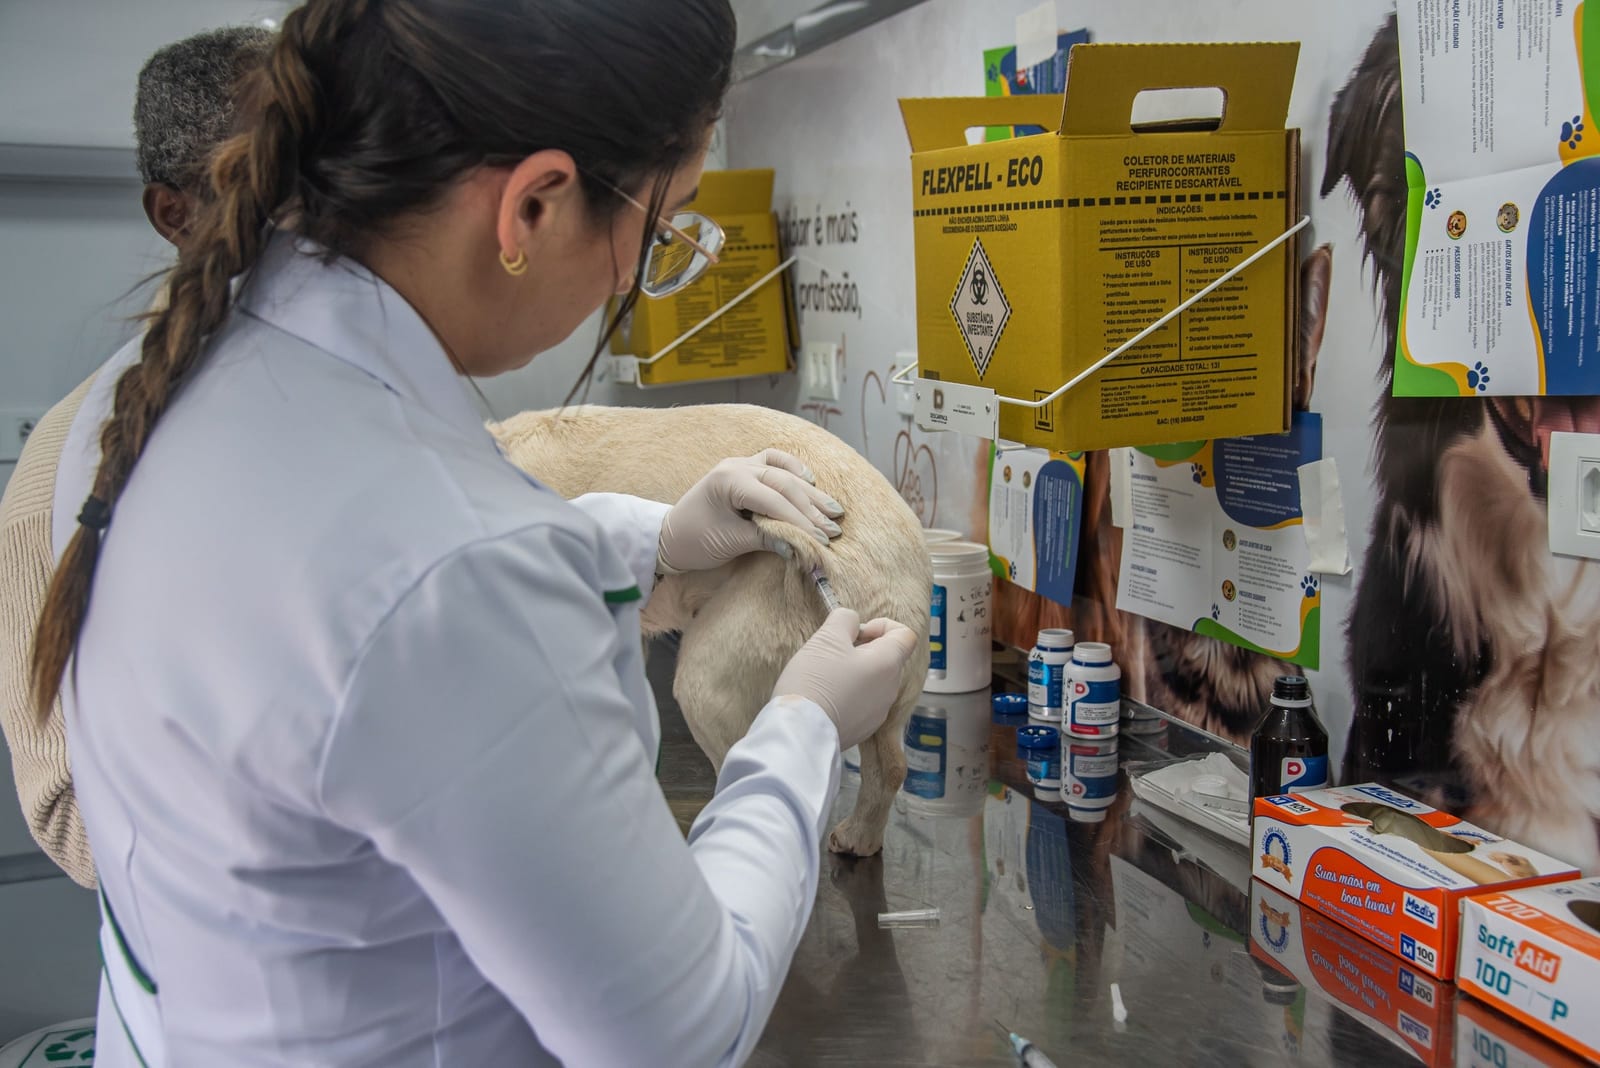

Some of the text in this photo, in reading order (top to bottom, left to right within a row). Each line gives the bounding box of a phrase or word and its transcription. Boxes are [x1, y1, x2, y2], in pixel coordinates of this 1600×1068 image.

[1124, 154, 1236, 166] COLETOR DE MATERIAIS
[922, 162, 992, 196] FLEXPELL
[1007, 155, 1043, 188] ECO
[1129, 166, 1230, 178] PERFUROCORTANTES
[1116, 176, 1242, 191] RECIPIENTE DESCARTÁVEL
[1156, 204, 1203, 215] INDICAÇÕES:
[815, 204, 824, 247] é
[826, 200, 859, 245] mais
[1115, 246, 1243, 260] INSTRUÇÕES INSTRUCCIONES
[1125, 260, 1134, 268] DE
[799, 266, 863, 326] profissão,
[967, 311, 994, 324] SUBSTÂNCIA
[967, 324, 993, 336] INFECTANTE
[978, 347, 983, 360] 6
[1141, 364, 1184, 374] CAPACIDADE
[1186, 363, 1208, 372] TOTAL:
[1291, 803, 1311, 812] 100
[1315, 864, 1381, 893] Suas mãos em
[1341, 888, 1395, 915] boas luvas!
[1405, 896, 1435, 920] Medix
[1486, 896, 1543, 920] 100
[1403, 942, 1434, 962] M 100
[1477, 924, 1556, 979] Soft Aid
[1475, 958, 1512, 996] 100
[1551, 998, 1568, 1020] P
